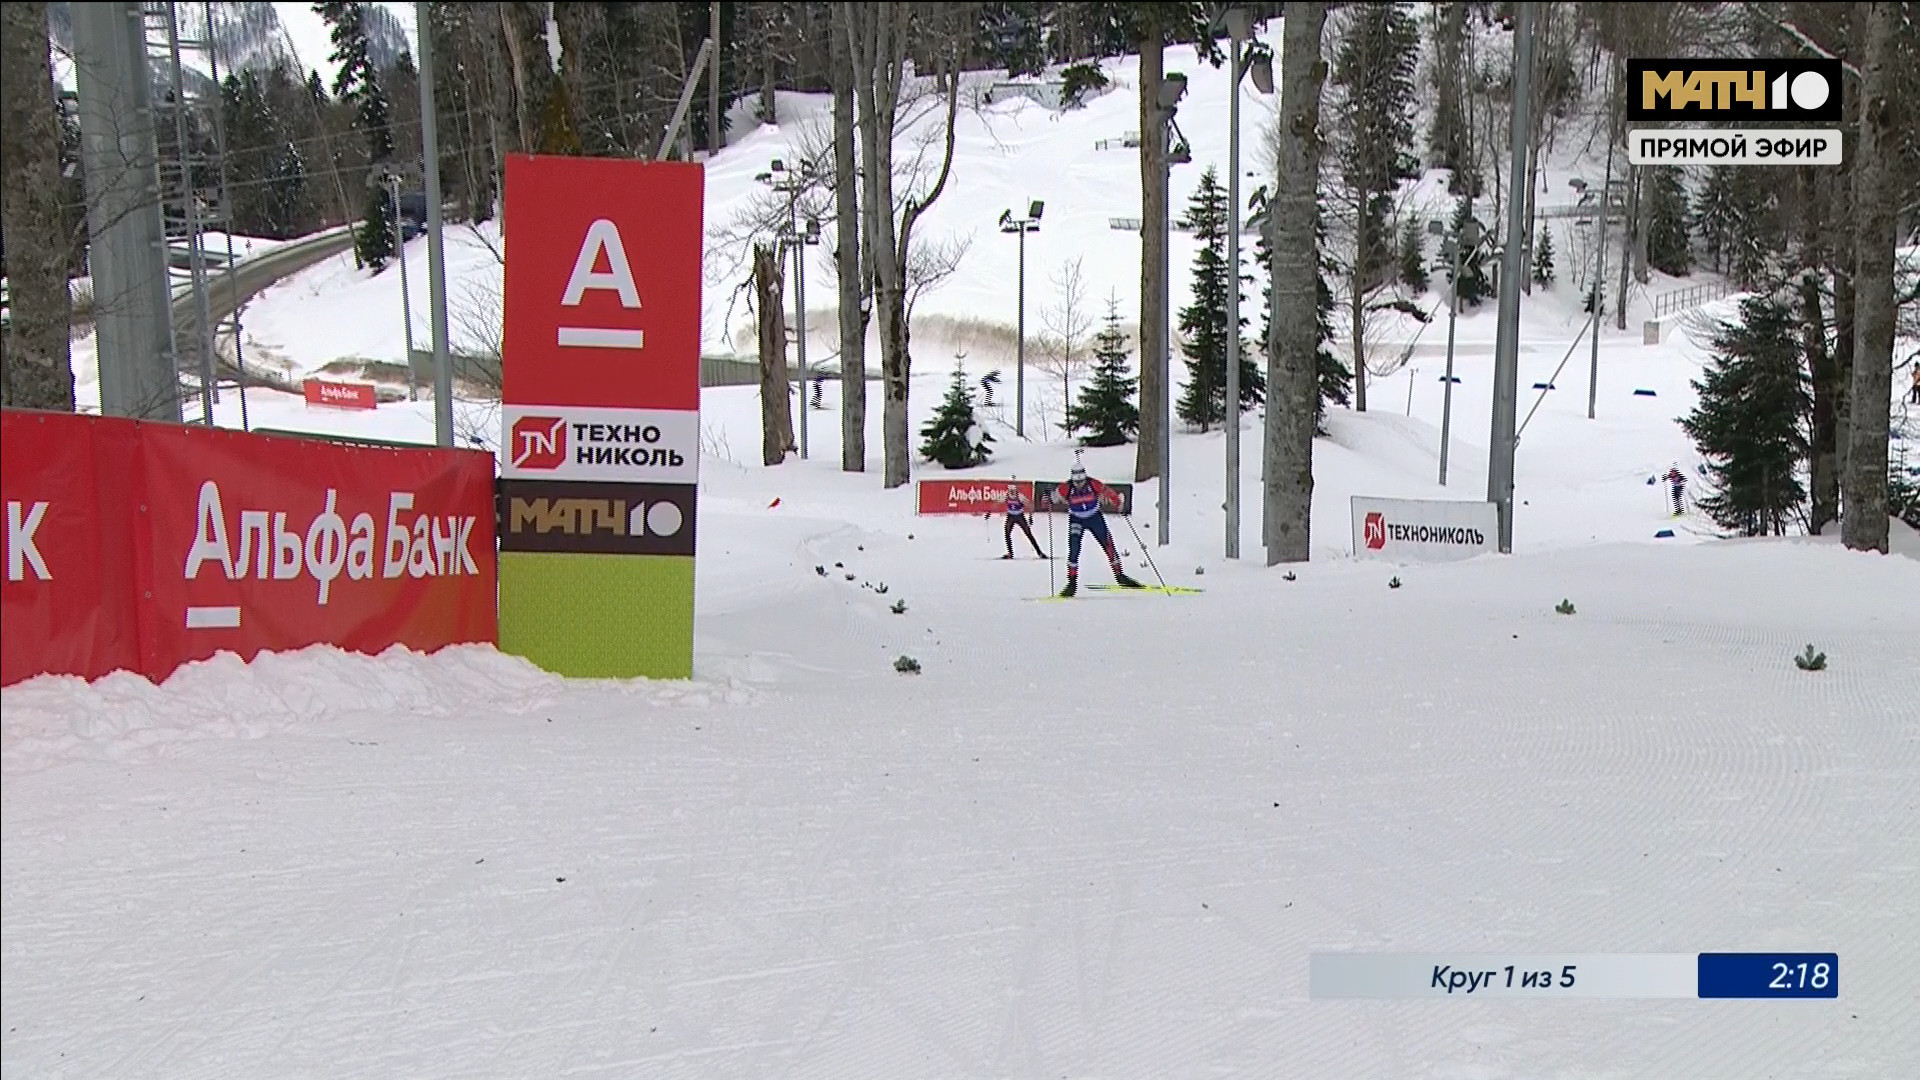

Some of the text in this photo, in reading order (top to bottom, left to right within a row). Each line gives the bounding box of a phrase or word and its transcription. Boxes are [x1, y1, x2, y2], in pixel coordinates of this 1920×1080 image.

[573, 423, 661, 443] ТЕХНО
[576, 446, 685, 467] НИКОЛЬ
[948, 485, 982, 505] Альфа
[184, 480, 480, 605] Альфа Банк
[1387, 523, 1485, 546] ТЕХНОНИКОЛЬ
